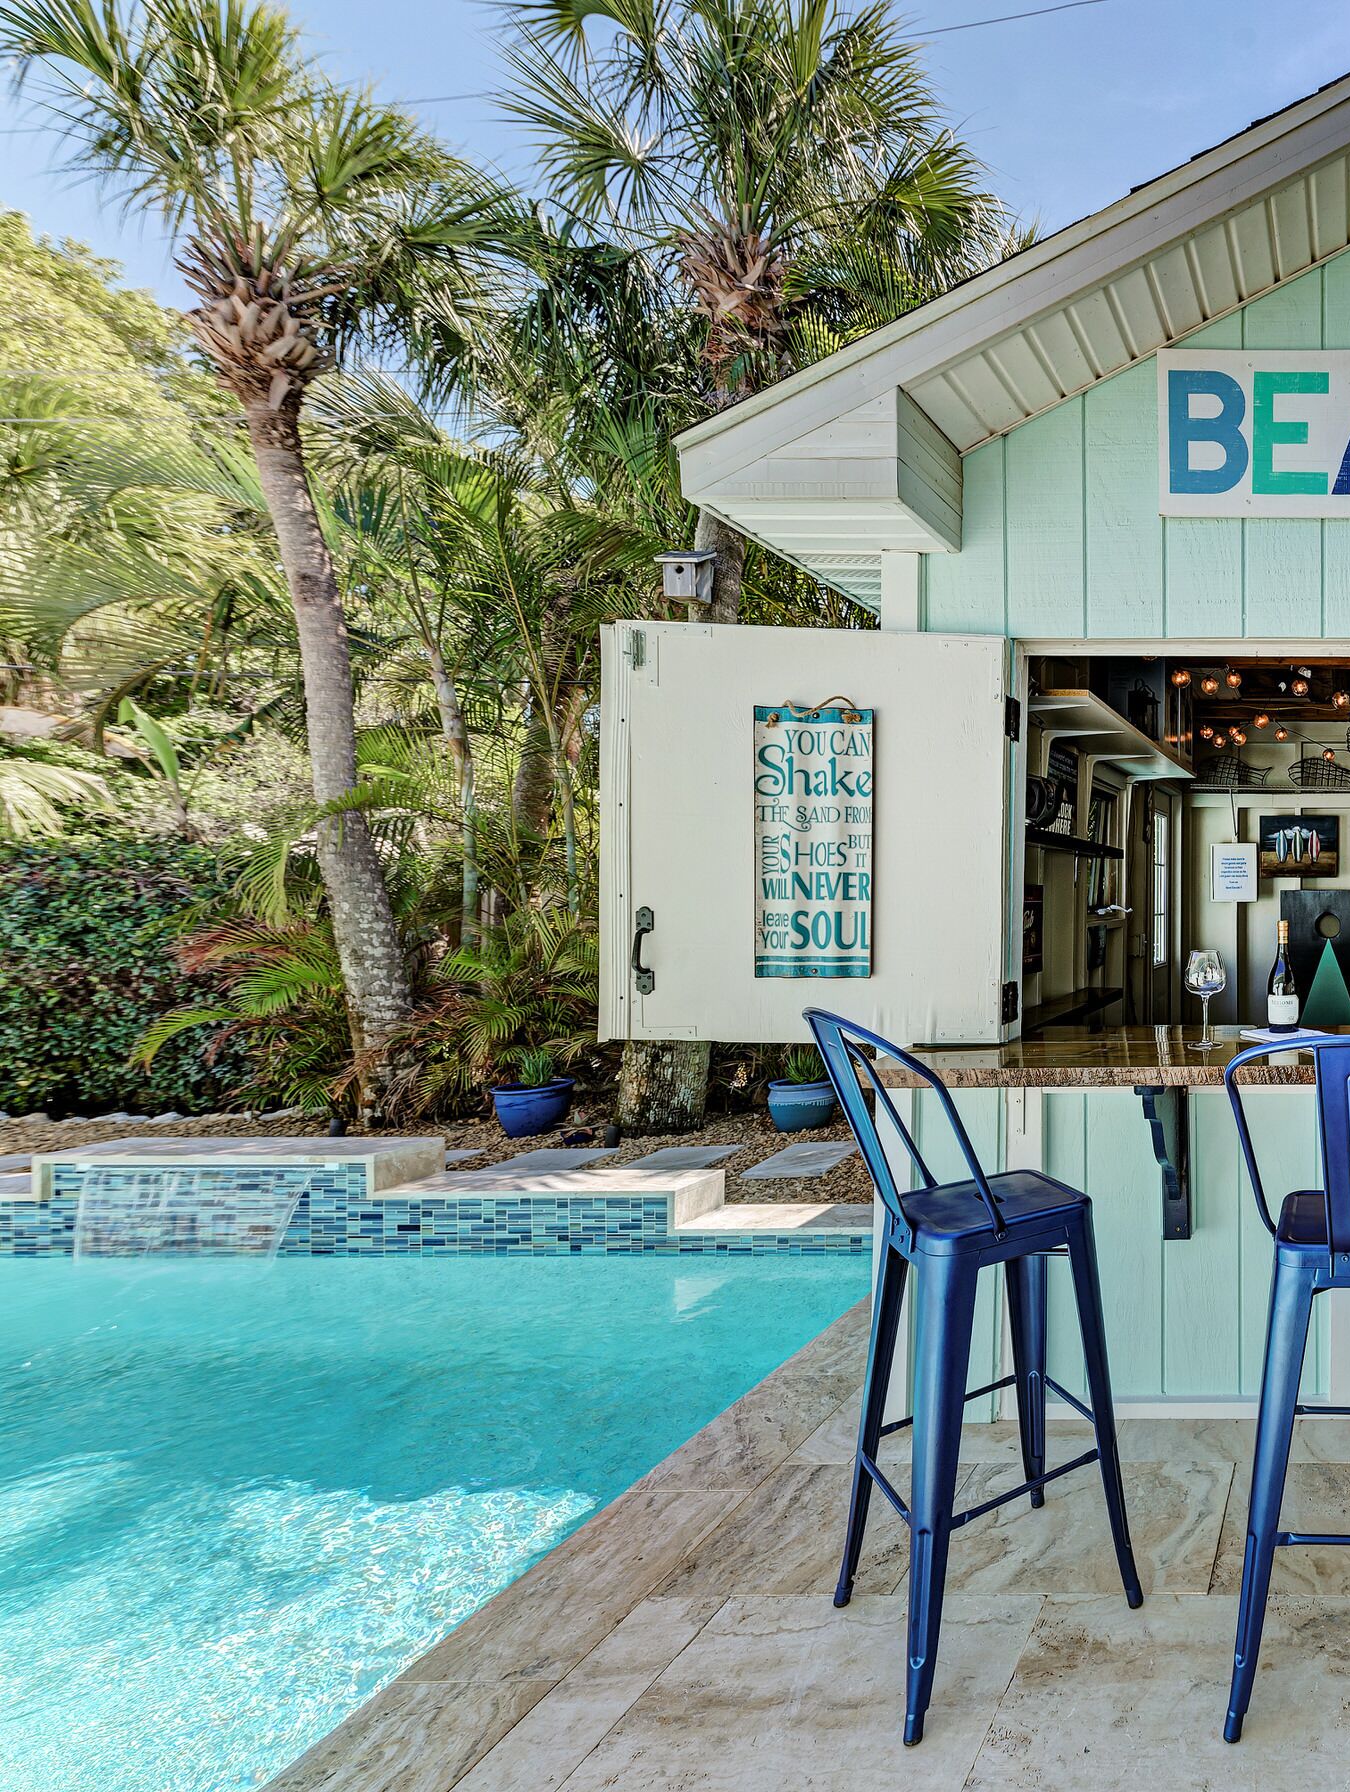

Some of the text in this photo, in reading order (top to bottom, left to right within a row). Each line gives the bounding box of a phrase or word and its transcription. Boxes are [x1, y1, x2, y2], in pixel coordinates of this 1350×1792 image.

[784, 729, 871, 757] YOU CAN
[754, 744, 872, 797] Shake
[796, 805, 841, 823] SAND
[844, 806, 872, 824] FROM
[761, 835, 780, 876] YOUR
[780, 832, 848, 875] SHOES
[848, 834, 872, 849] BUT
[855, 853, 867, 867] IT
[761, 871, 871, 901] WILL NEVER
[762, 910, 789, 927] leave
[790, 910, 871, 950] SOUL
